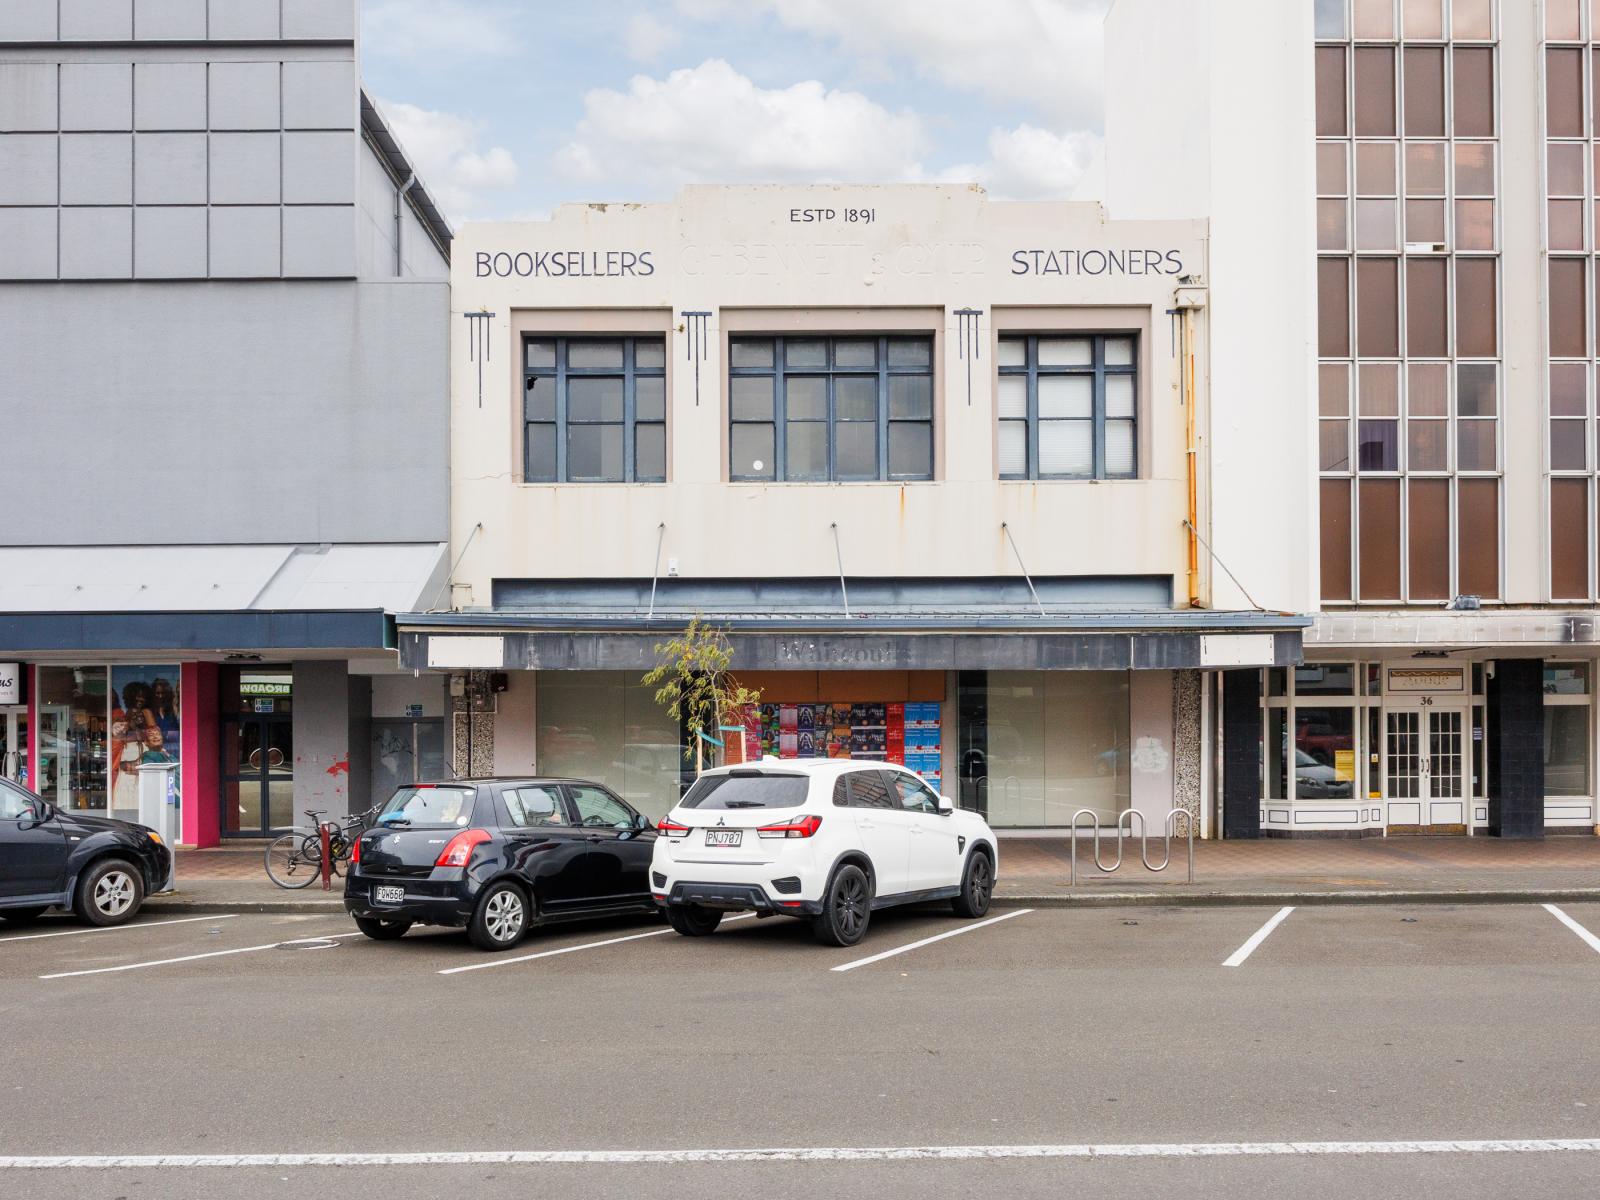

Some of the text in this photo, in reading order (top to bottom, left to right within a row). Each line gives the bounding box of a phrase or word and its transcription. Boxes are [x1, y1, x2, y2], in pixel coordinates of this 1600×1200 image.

[790, 208, 875, 224] ESTD 1891
[476, 252, 654, 277] BOOKSELLERS
[1011, 250, 1183, 275] STATIONERS
[1420, 696, 1433, 705] 36
[707, 832, 741, 844] PNJ707
